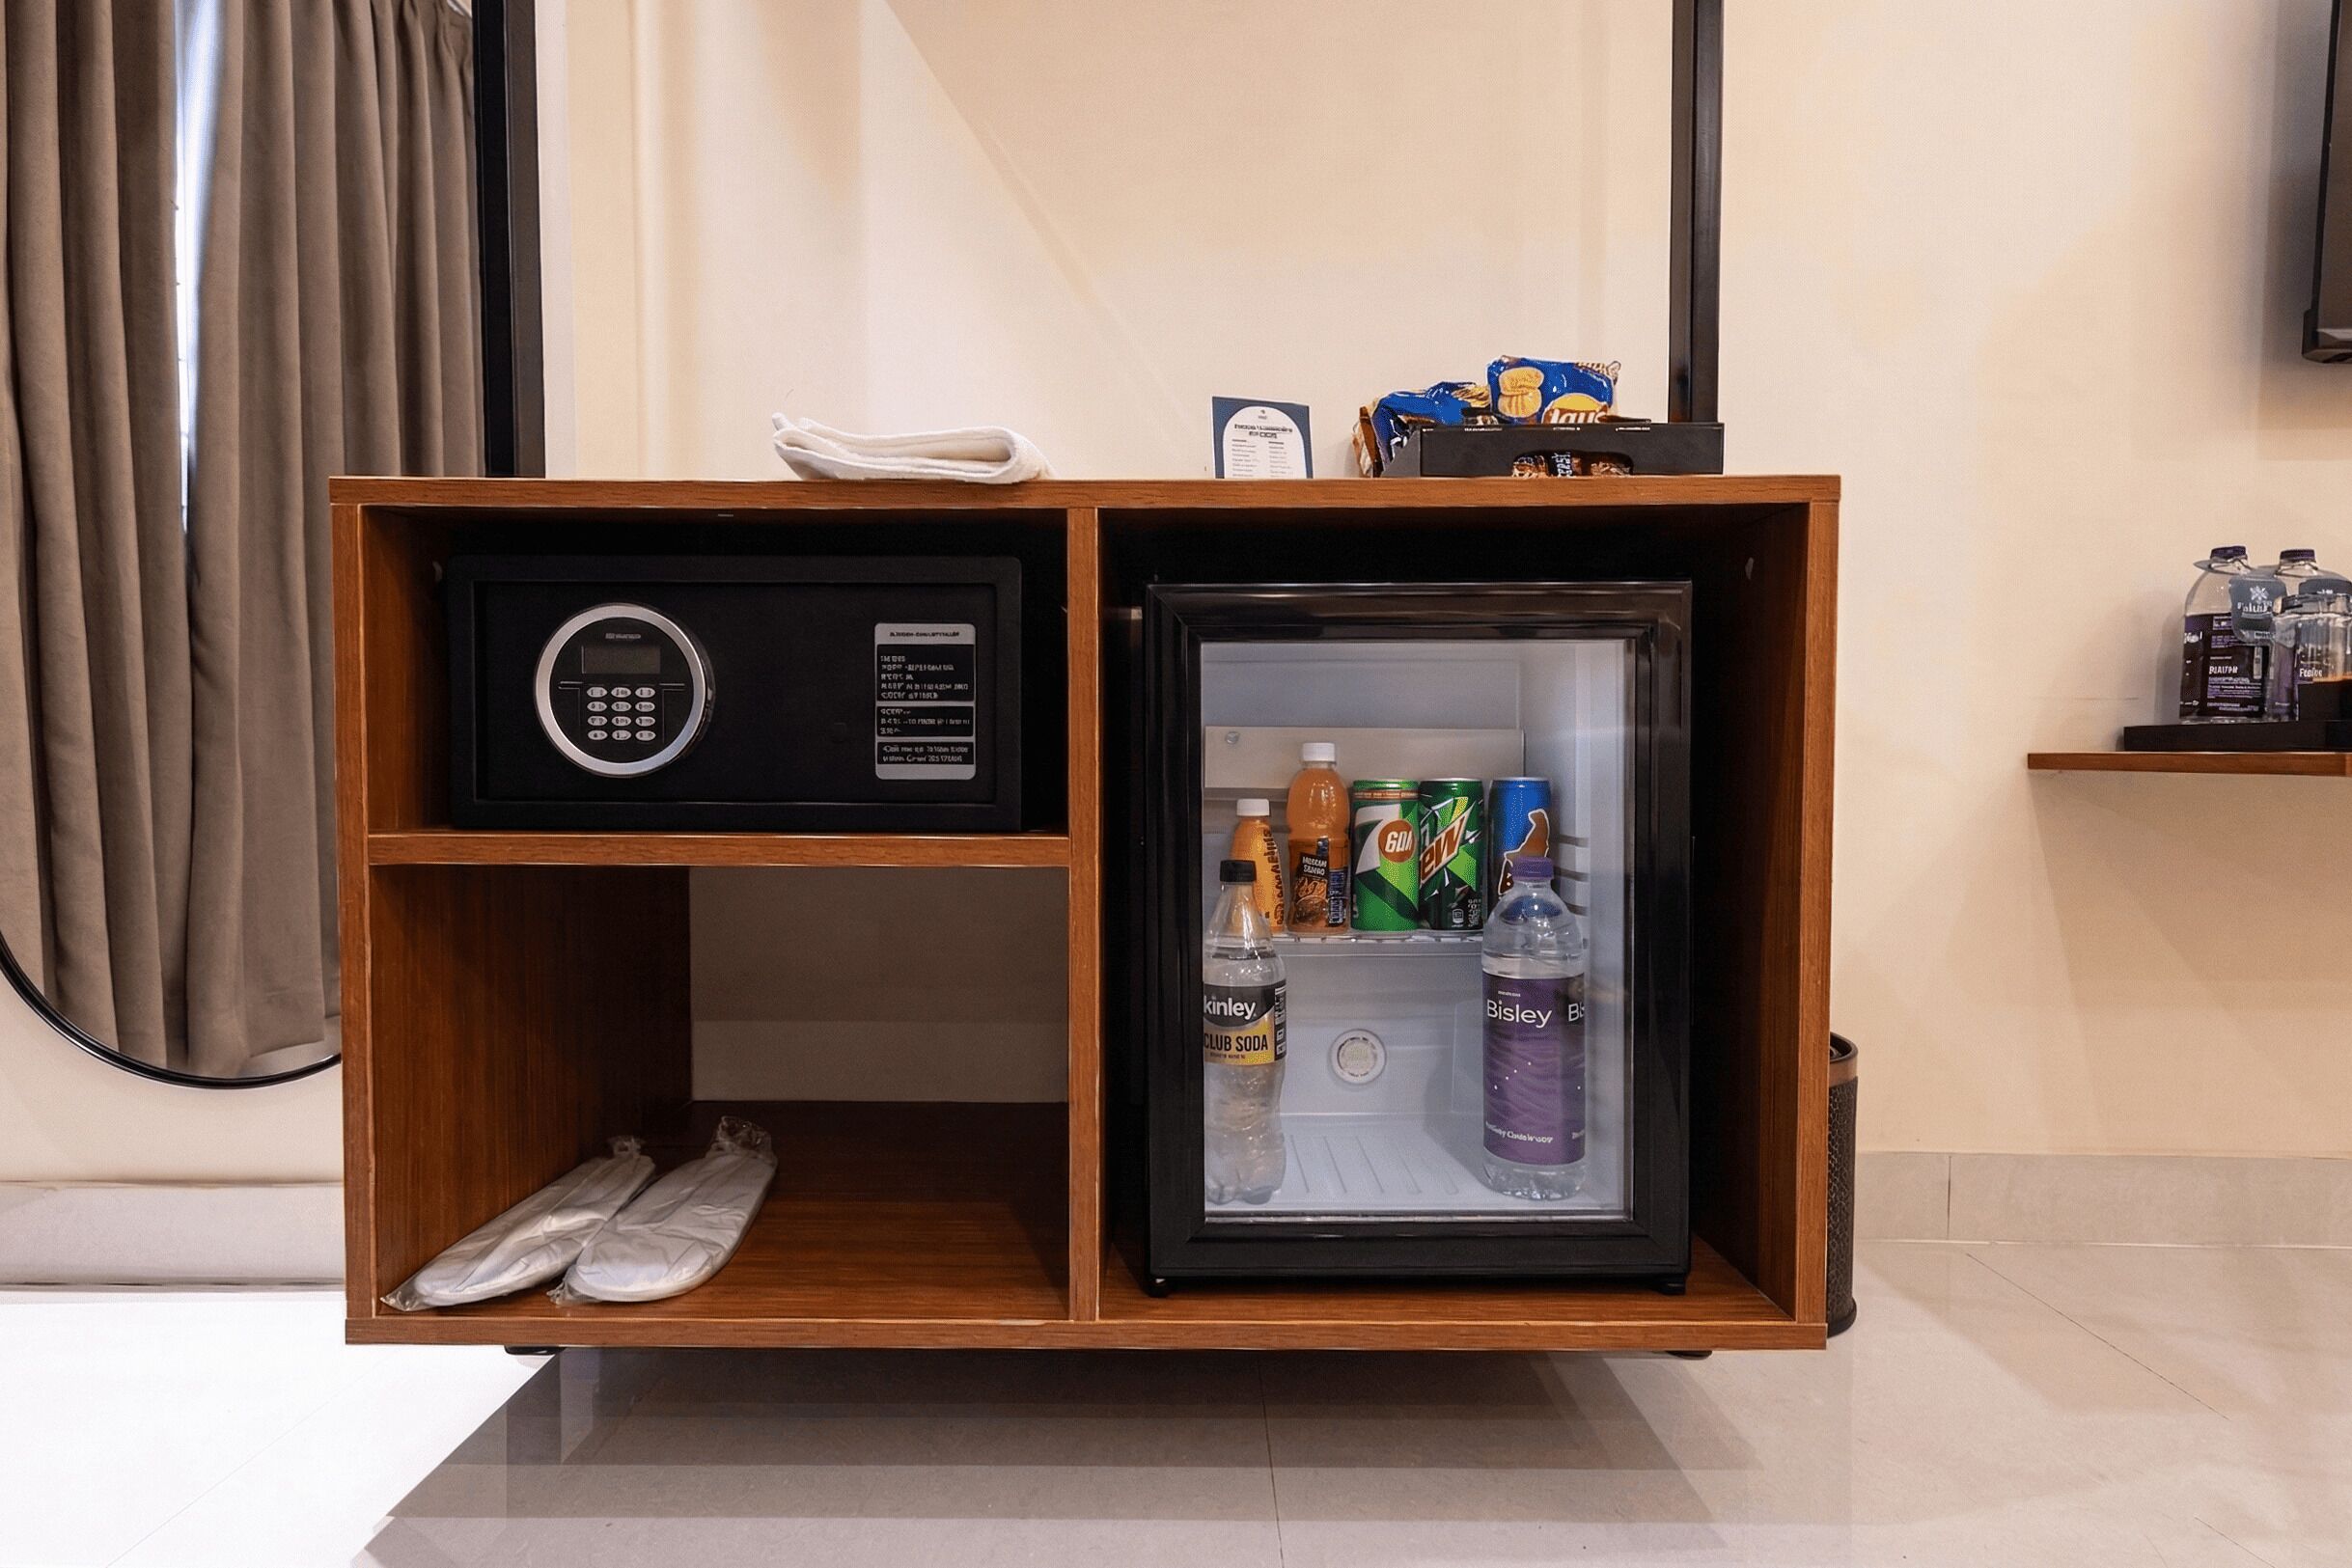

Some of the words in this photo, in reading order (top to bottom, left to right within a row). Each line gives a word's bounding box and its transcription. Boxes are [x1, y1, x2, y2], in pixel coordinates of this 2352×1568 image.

[1487, 999, 1553, 1029] Bisley
[1204, 1032, 1232, 1052] CLUB
[1235, 1033, 1269, 1053] SODA
